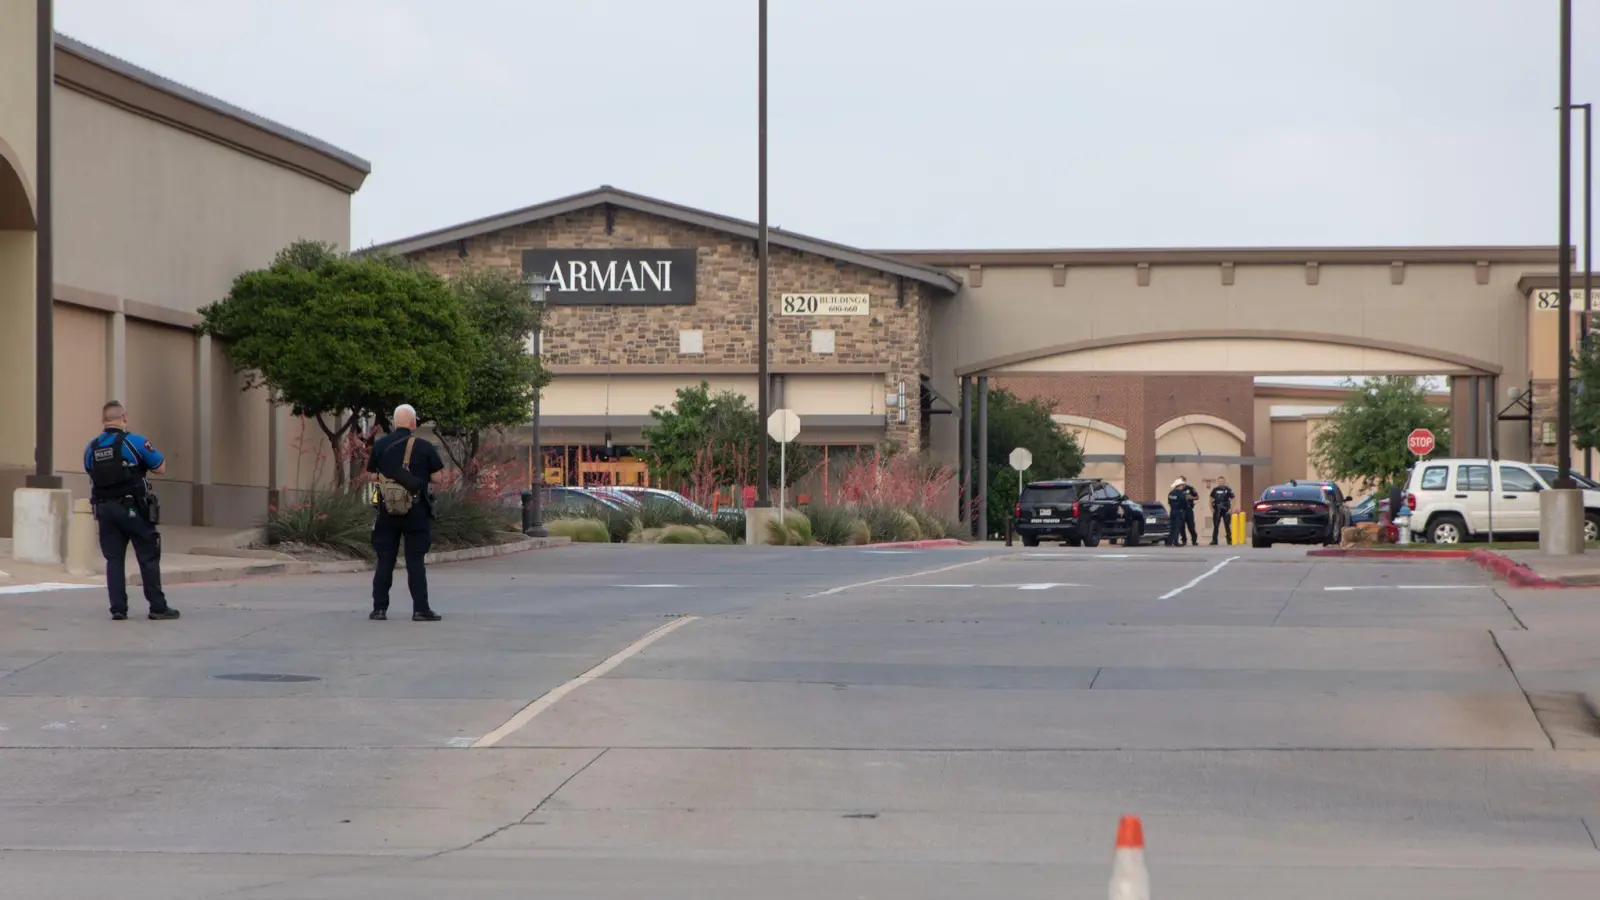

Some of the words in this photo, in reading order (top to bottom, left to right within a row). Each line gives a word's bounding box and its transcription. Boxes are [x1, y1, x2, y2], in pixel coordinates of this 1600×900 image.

[545, 260, 672, 292] ARMANI
[784, 295, 818, 313] 820
[820, 296, 861, 304] BUILDING
[862, 296, 867, 304] 6
[1410, 437, 1433, 447] STOP
